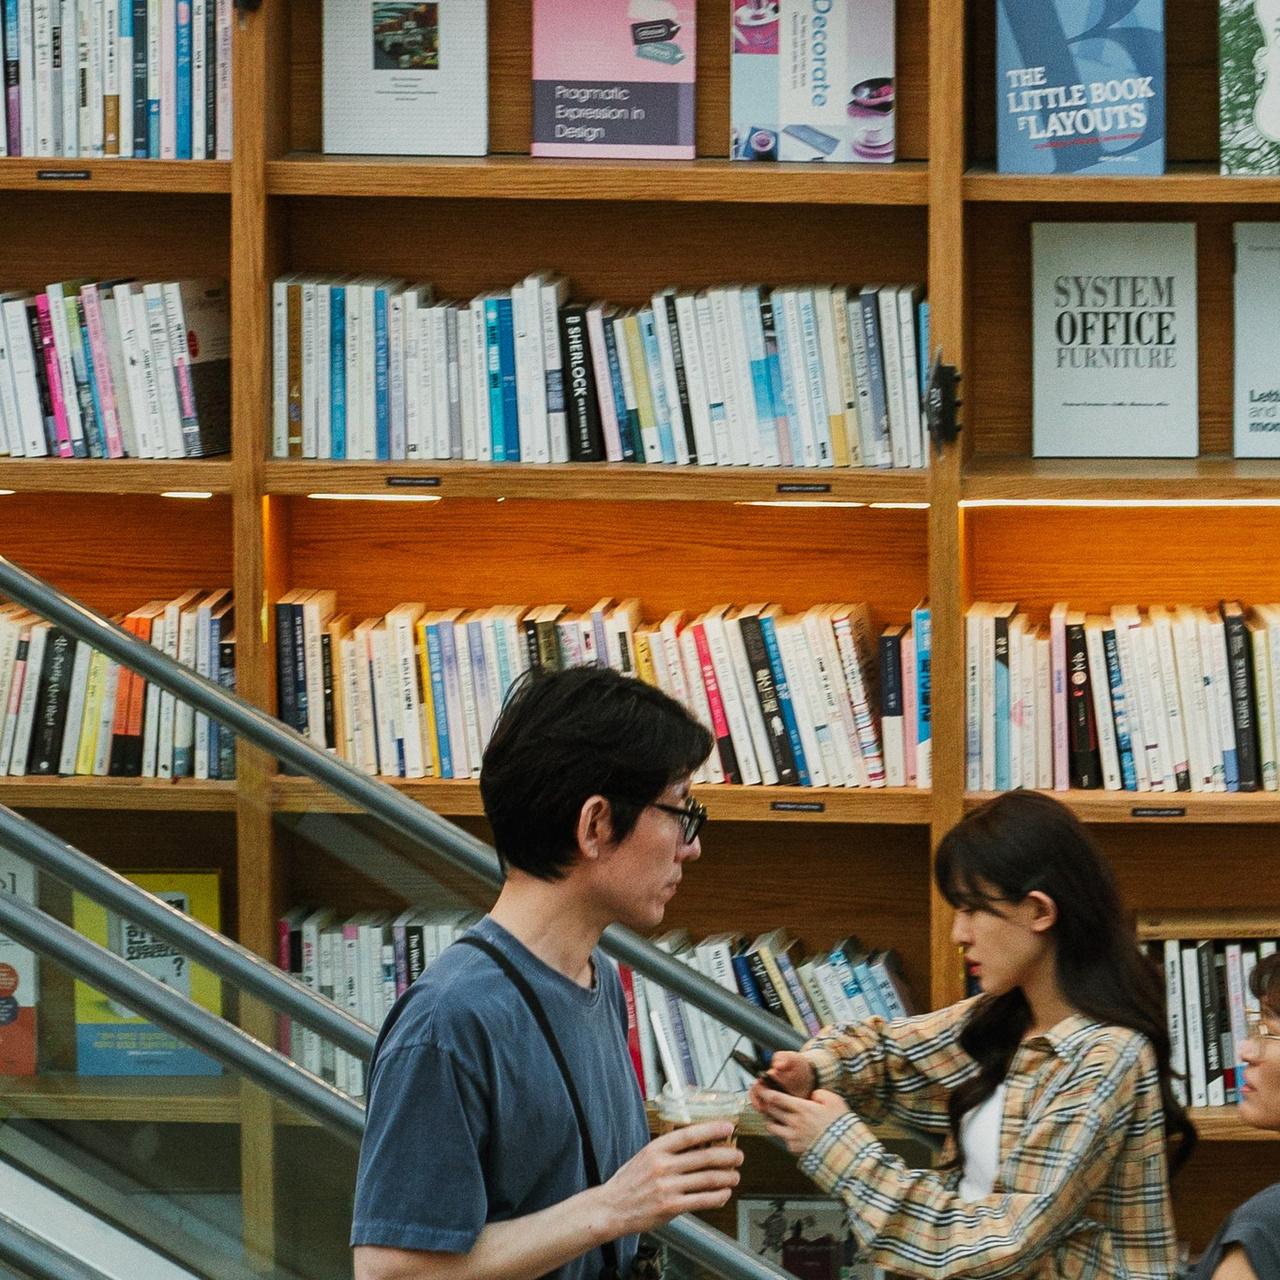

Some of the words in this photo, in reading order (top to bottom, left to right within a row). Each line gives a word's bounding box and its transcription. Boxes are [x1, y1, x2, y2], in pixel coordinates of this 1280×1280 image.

[1006, 66, 1047, 88] THE
[555, 86, 630, 104] Pragmatic
[1006, 85, 1088, 114] LITTLE
[1089, 75, 1156, 104] BOOK
[555, 105, 629, 123] Expression
[630, 106, 646, 121] in
[1028, 102, 1148, 140] LAYOUTS
[555, 124, 606, 141] Design
[1053, 276, 1175, 308] SYSTEM
[1055, 311, 1177, 345] OFFICE
[566, 325, 589, 396] SHERLOCK
[1056, 347, 1177, 369] FURNITURE
[1249, 405, 1278, 419] and
[409, 933, 422, 948] The
[409, 949, 422, 970] World
